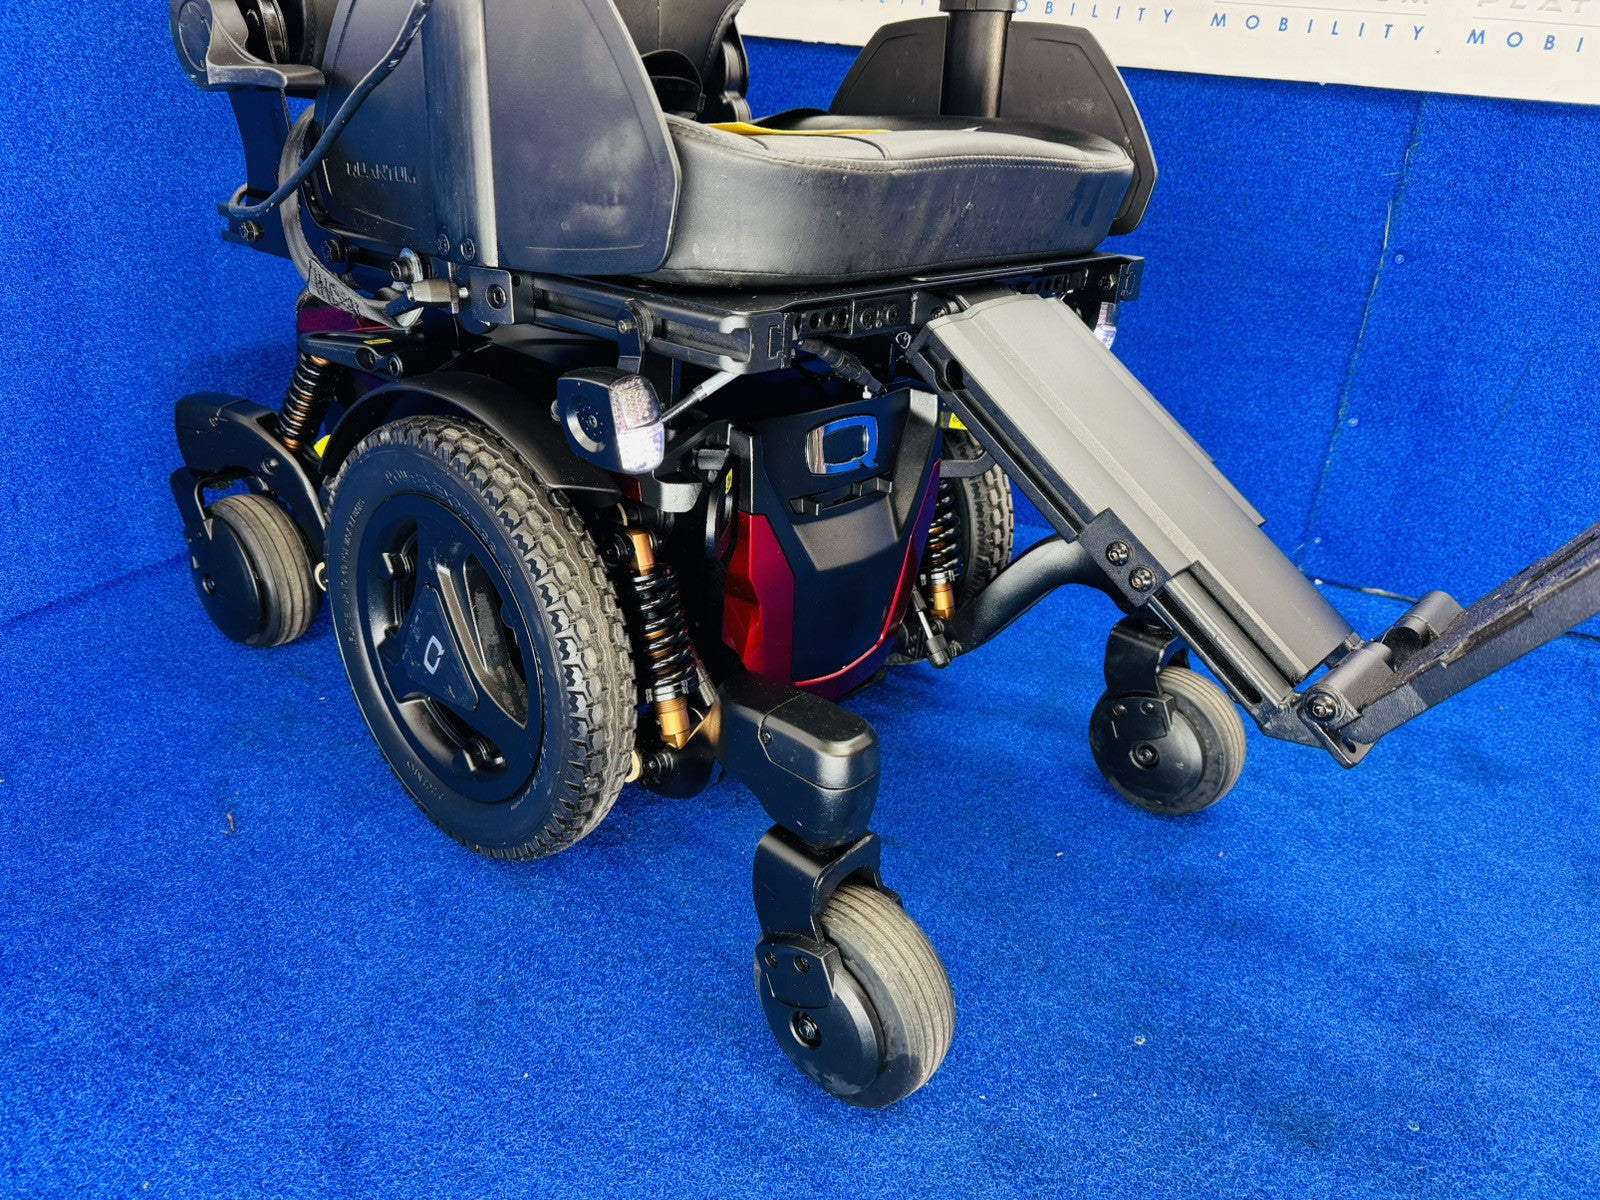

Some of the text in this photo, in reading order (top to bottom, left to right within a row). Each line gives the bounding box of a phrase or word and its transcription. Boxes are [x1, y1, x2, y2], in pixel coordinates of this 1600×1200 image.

[1210, 12, 1424, 41] MOBILITY
[1466, 28, 1584, 52] MOBI
[345, 161, 417, 184] QUANTUM
